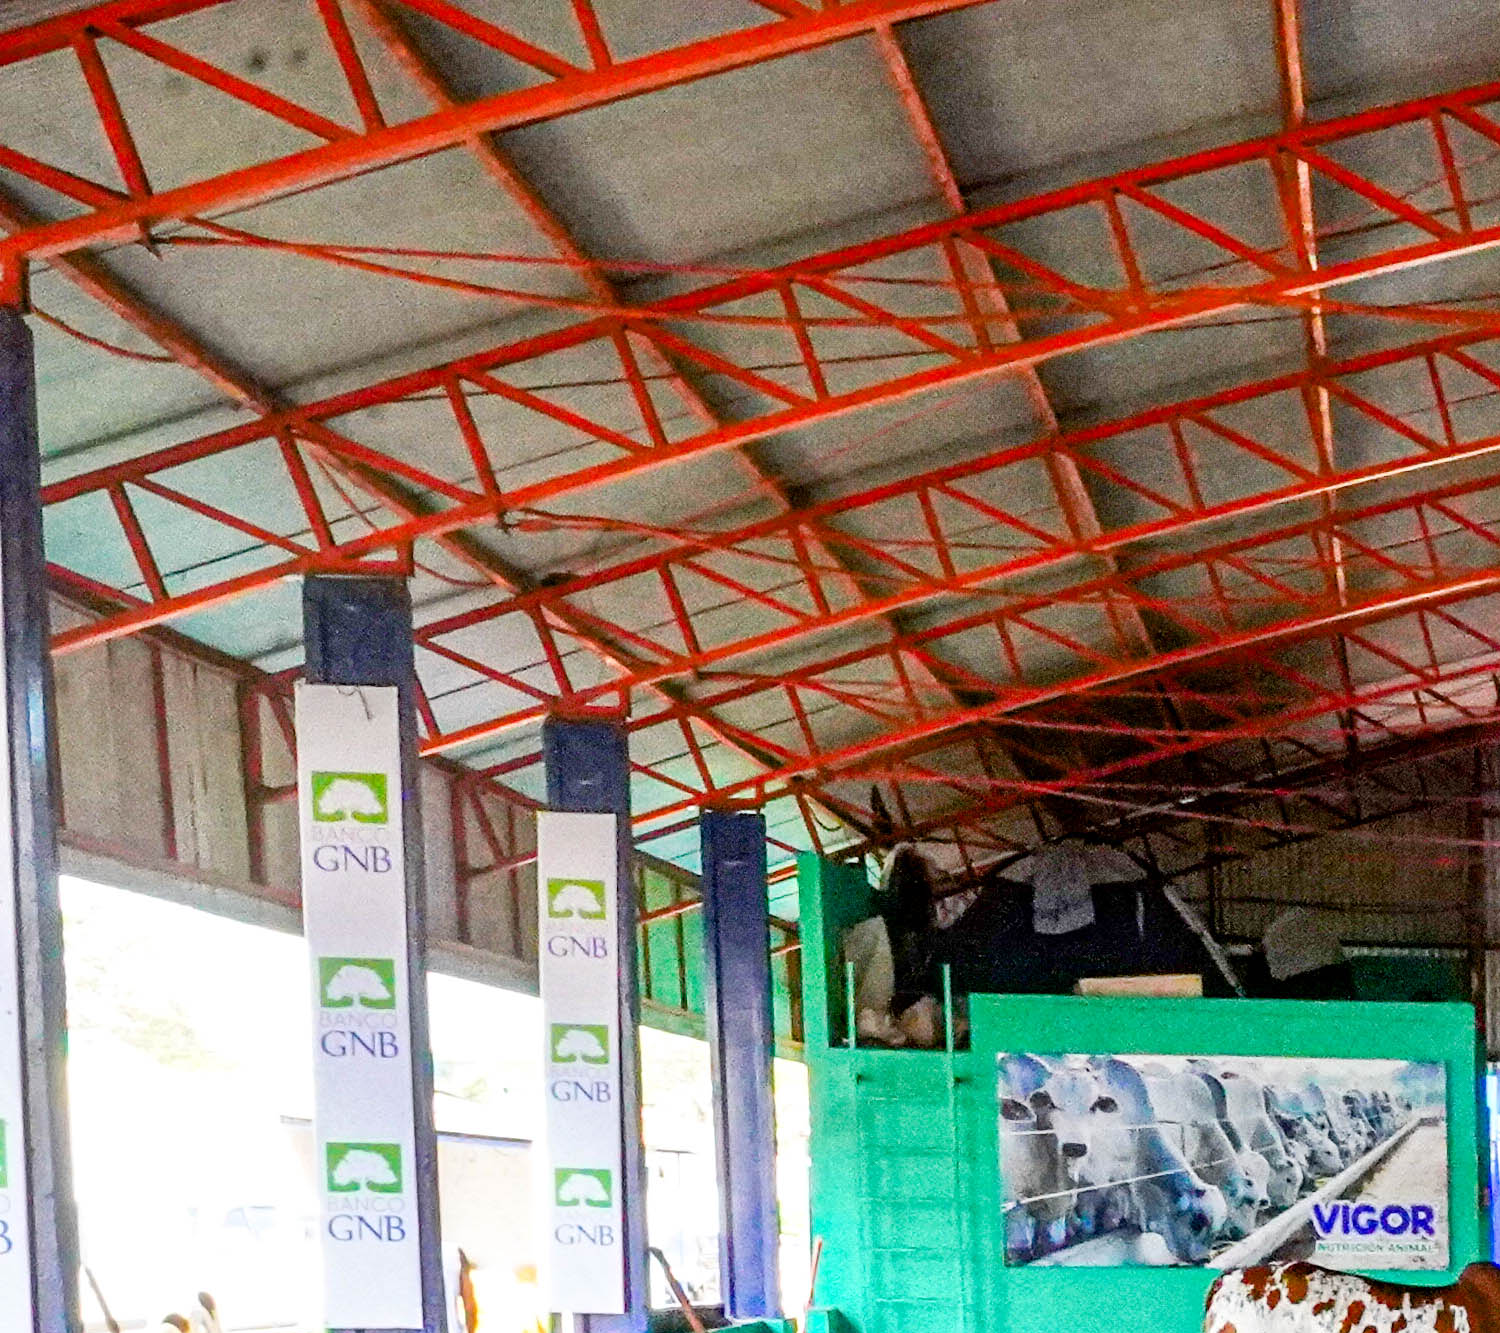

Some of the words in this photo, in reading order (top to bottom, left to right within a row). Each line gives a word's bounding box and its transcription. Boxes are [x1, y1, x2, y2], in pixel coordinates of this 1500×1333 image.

[313, 845, 392, 873] GNB
[546, 935, 609, 960] GNB
[319, 1011, 397, 1028] BANCO
[319, 1031, 399, 1059] GNB
[550, 1079, 612, 1104] GNB
[327, 1197, 405, 1213] BANCO
[327, 1214, 407, 1243] GNB
[1313, 1203, 1436, 1236] VIGOR
[554, 1223, 615, 1247] GNB
